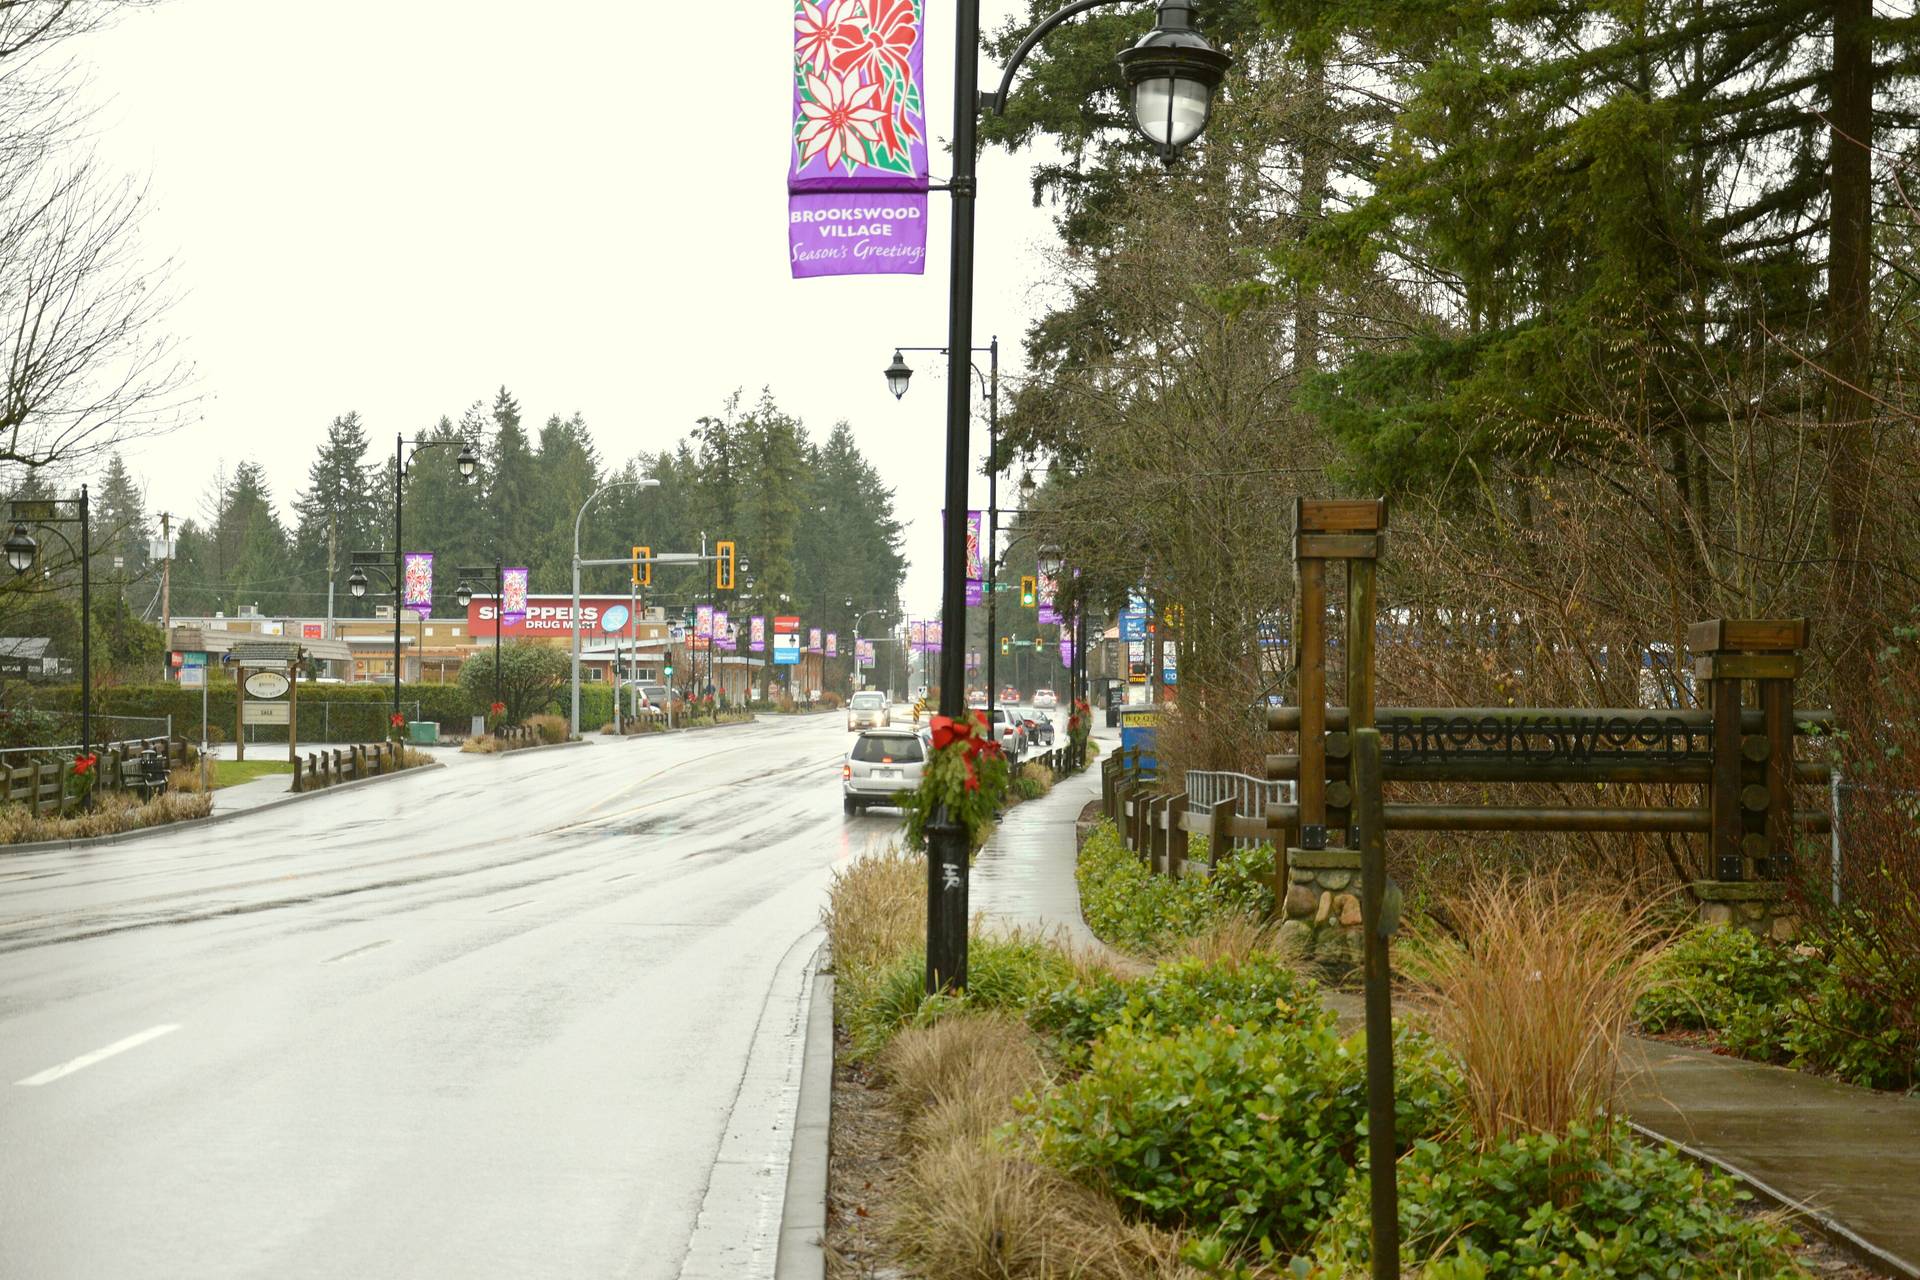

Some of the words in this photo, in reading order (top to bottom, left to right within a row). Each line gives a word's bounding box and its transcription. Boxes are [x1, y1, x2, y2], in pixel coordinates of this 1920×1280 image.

[790, 206, 921, 224] BROOKSWOOD
[818, 223, 893, 238] VILLAGE
[791, 242, 848, 263] Season's
[853, 238, 926, 265] Greetings
[478, 606, 599, 620] SPPERS
[525, 620, 560, 629] DRUG
[1391, 715, 1693, 763] BROOKSWOOD
